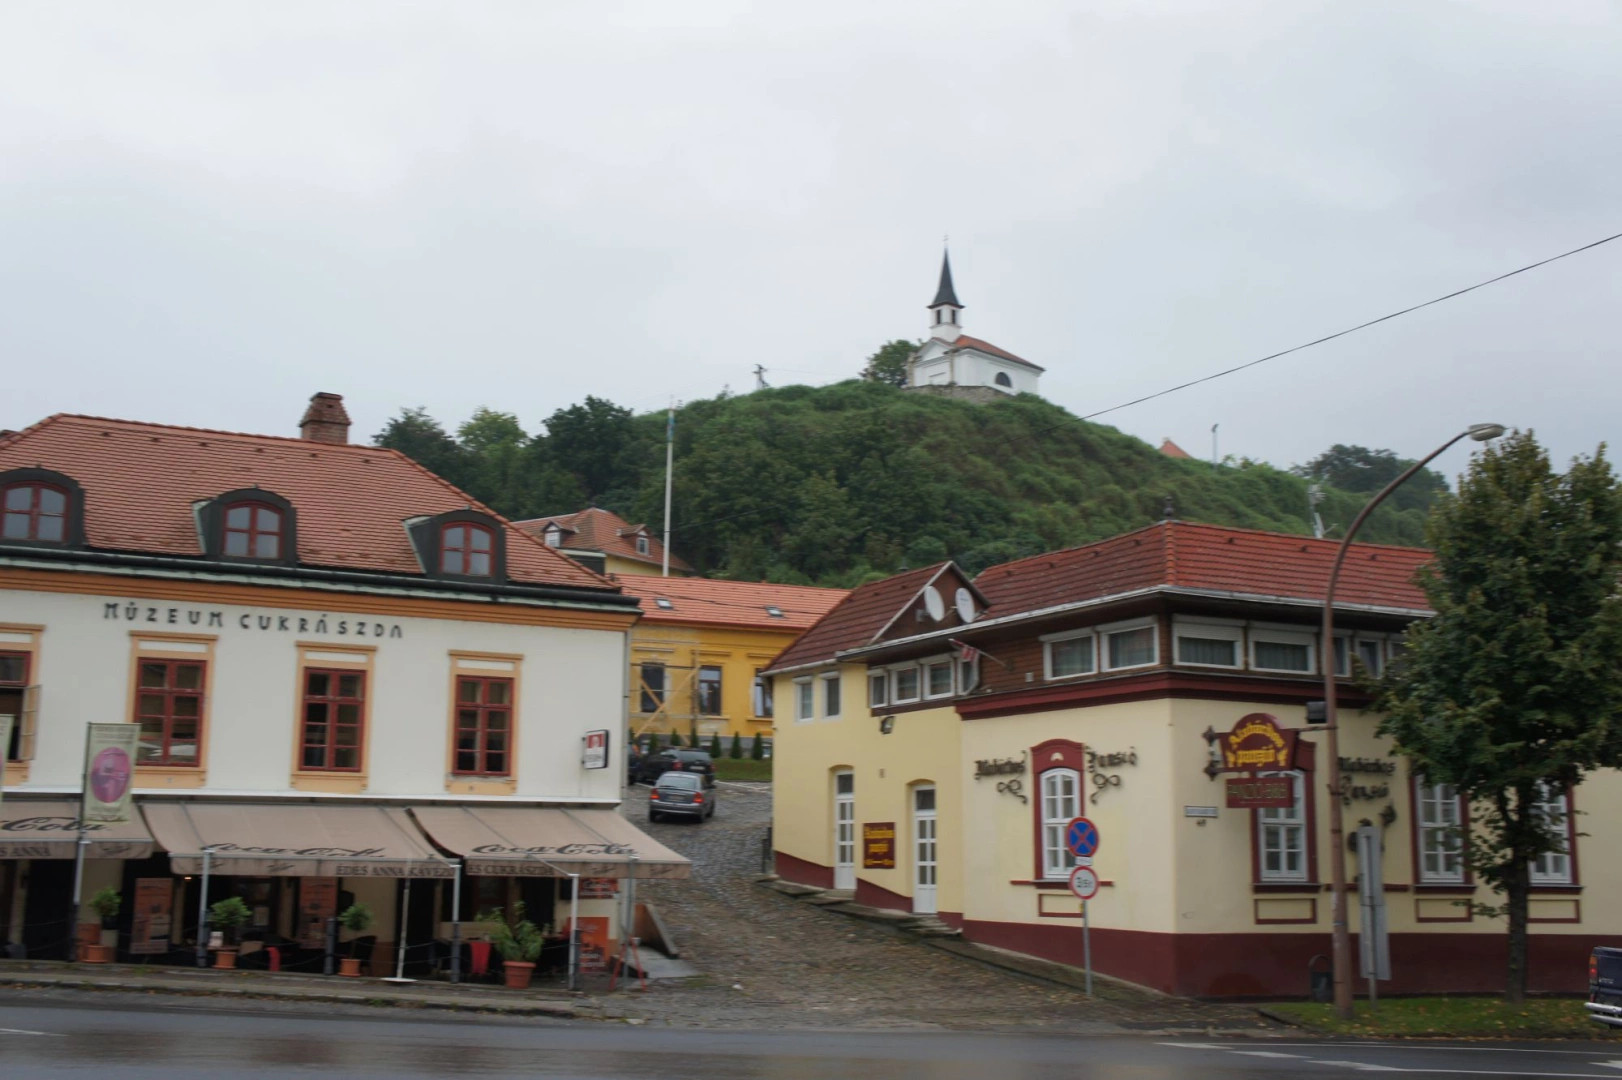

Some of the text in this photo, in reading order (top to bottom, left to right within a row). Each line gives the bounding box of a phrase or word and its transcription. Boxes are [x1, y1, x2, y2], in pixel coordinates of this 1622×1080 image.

[103, 601, 404, 639] MÚZEUM CUKRÁSZDA
[471, 843, 640, 856] Coca-Cola
